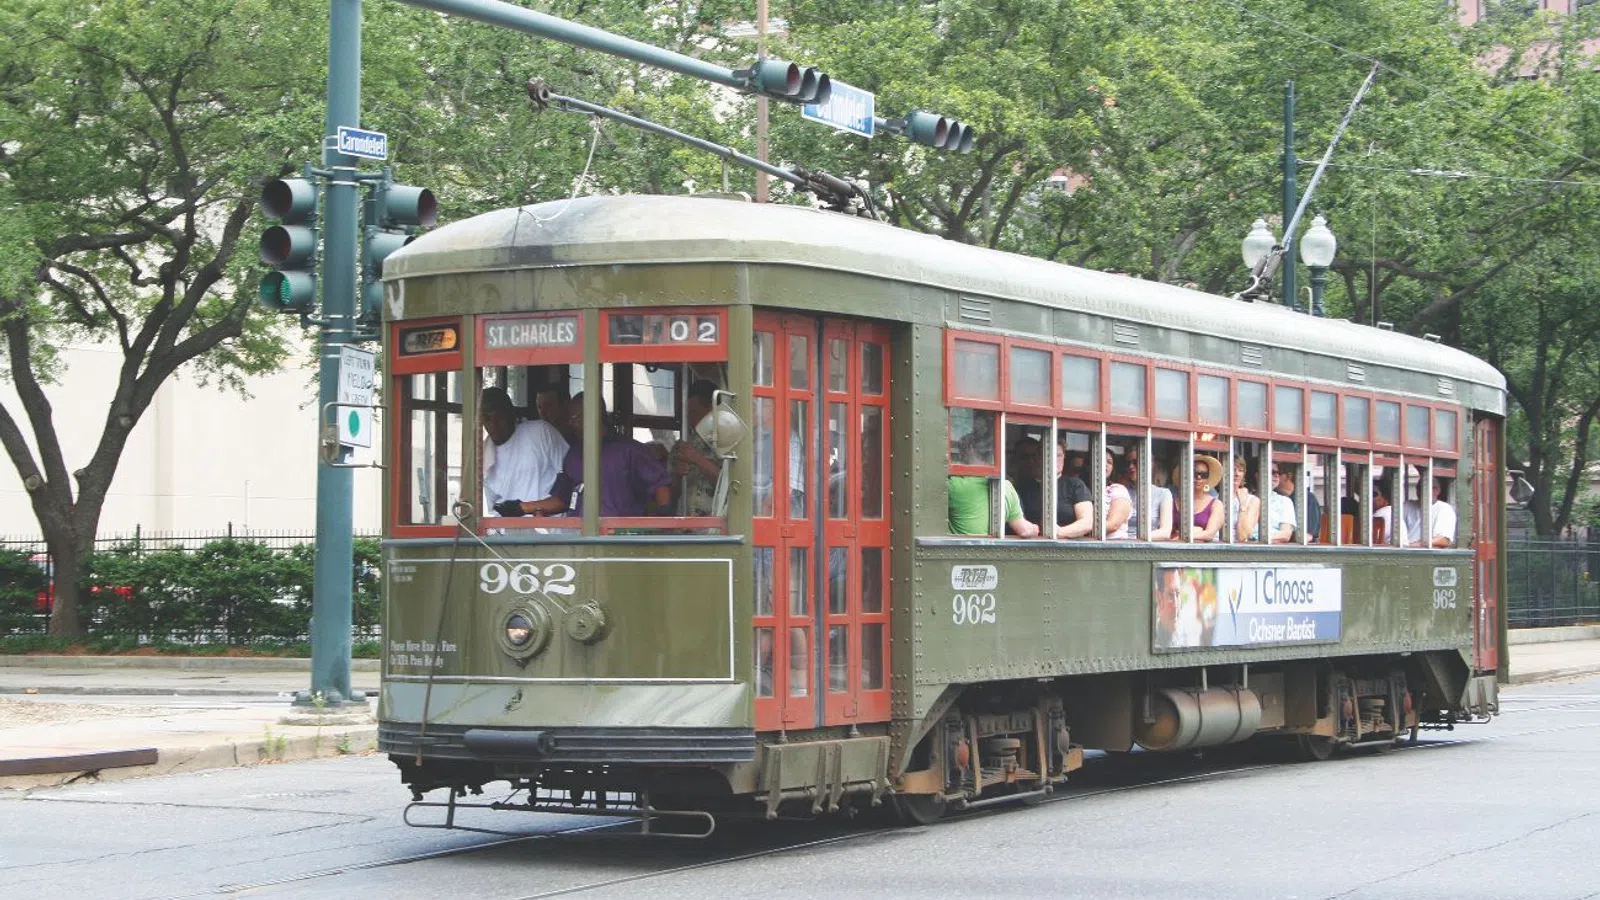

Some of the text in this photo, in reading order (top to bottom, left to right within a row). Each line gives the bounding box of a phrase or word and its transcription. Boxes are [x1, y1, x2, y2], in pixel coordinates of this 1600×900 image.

[341, 131, 384, 155] Carondelet
[488, 322, 574, 346] ST. CHARLES
[479, 562, 576, 596] 962
[1254, 567, 1314, 605] I Choose
[952, 592, 996, 625] 962
[1433, 588, 1456, 609] 962
[1249, 616, 1316, 641] Ochsner Baptist
